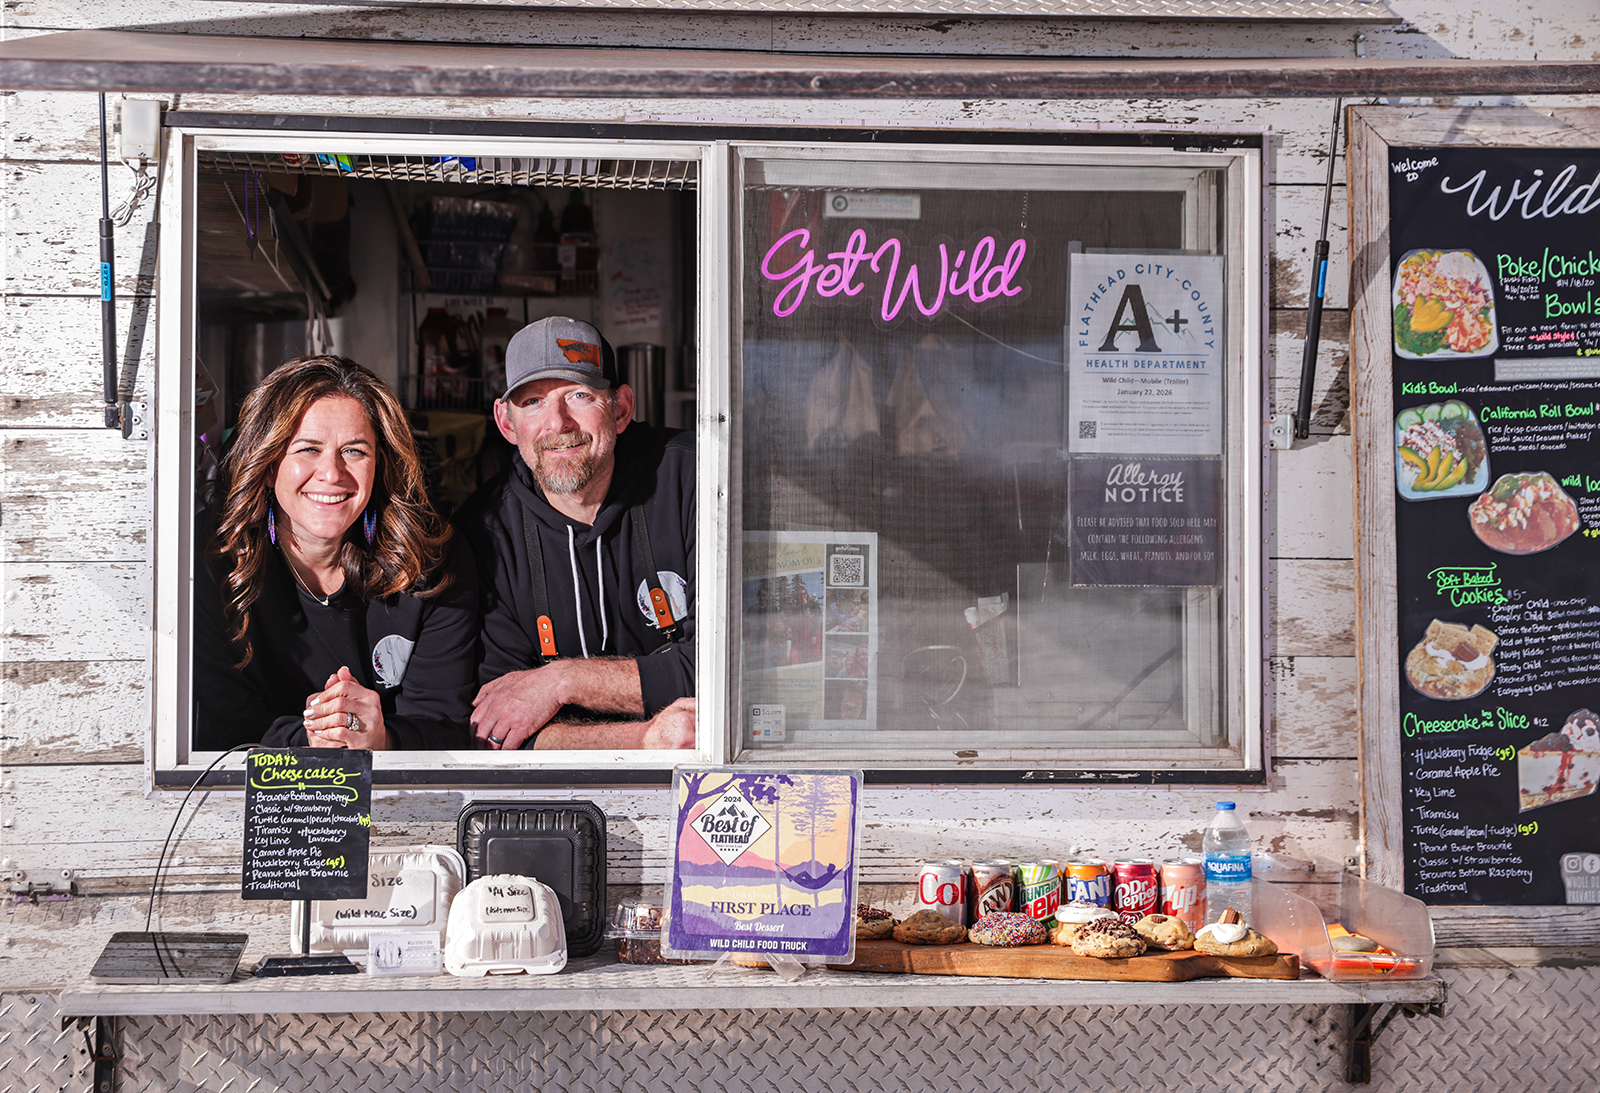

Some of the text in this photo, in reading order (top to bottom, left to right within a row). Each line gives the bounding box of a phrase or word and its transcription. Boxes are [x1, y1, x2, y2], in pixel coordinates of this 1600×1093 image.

[1391, 157, 1439, 174] Welcome
[1405, 172, 1419, 182] to
[761, 228, 874, 317] Get
[870, 236, 1027, 321] Wild
[1079, 269, 1126, 347] FLATHEAD
[1086, 359, 1207, 369] HEALTH DEPARTMENT
[1117, 389, 1143, 397] January
[1144, 389, 1155, 397] 22,
[1428, 382, 1458, 394] Bowl
[1481, 402, 1594, 422] California Roll Bowl
[1106, 462, 1184, 493] Allergy
[1105, 487, 1184, 502] NOTICE
[1077, 516, 1097, 527] PLEASE
[1099, 517, 1106, 527] BE
[1108, 517, 1134, 527] ADVISED
[1135, 517, 1150, 527] THAT
[1151, 517, 1168, 528] FOOD
[1169, 517, 1185, 528] SOLD
[1087, 534, 1116, 544] CONTAIN
[1118, 534, 1129, 544] THE
[1131, 534, 1168, 544] FOLLOWING
[1436, 570, 1495, 588] Soft Baked
[1450, 587, 1509, 607] Cookies
[1526, 598, 1550, 609] Child
[1523, 610, 1543, 621] Child
[1403, 712, 1481, 737] Cheesecake
[1496, 707, 1530, 730] Slice
[1533, 717, 1549, 727] $12
[1414, 746, 1466, 765] Huckleberry
[1467, 744, 1496, 760] Fudge
[1415, 763, 1501, 780] Caramel Apple Pie
[256, 790, 350, 807] Brownie Bottom Raspberry
[1415, 786, 1456, 802] Key Lime
[255, 804, 282, 814] Classic
[1416, 806, 1459, 820] Tiramisu
[252, 815, 279, 824] Turtle
[701, 814, 759, 837] Best of
[254, 825, 292, 836] Tiramisu
[269, 837, 291, 845] Lime
[307, 835, 343, 844] Lavender
[710, 834, 749, 844] FLATHEAD
[252, 846, 323, 858] Caramel Apple Pie
[1419, 841, 1448, 854] Peanut
[1477, 840, 1513, 852] Brownie
[252, 859, 300, 869] Huckleberry
[1418, 856, 1449, 867] Classic
[252, 869, 284, 880] Peanut
[310, 866, 349, 878] Brownie
[371, 873, 404, 887] Size
[1419, 867, 1457, 880] Brownie
[1488, 867, 1533, 884] Raspberry
[248, 879, 301, 890] Traditional
[1067, 875, 1111, 901] FANT
[1129, 880, 1149, 895] Dr
[1418, 881, 1468, 894] Traditional
[982, 883, 1009, 914] A&W
[1117, 883, 1157, 909] Pepper
[710, 901, 811, 916] FIRST PLACE
[734, 921, 785, 932] Best Dessert
[1124, 915, 1137, 925] 23
[710, 939, 807, 951] WILD CHILD FOOD TRUCK
